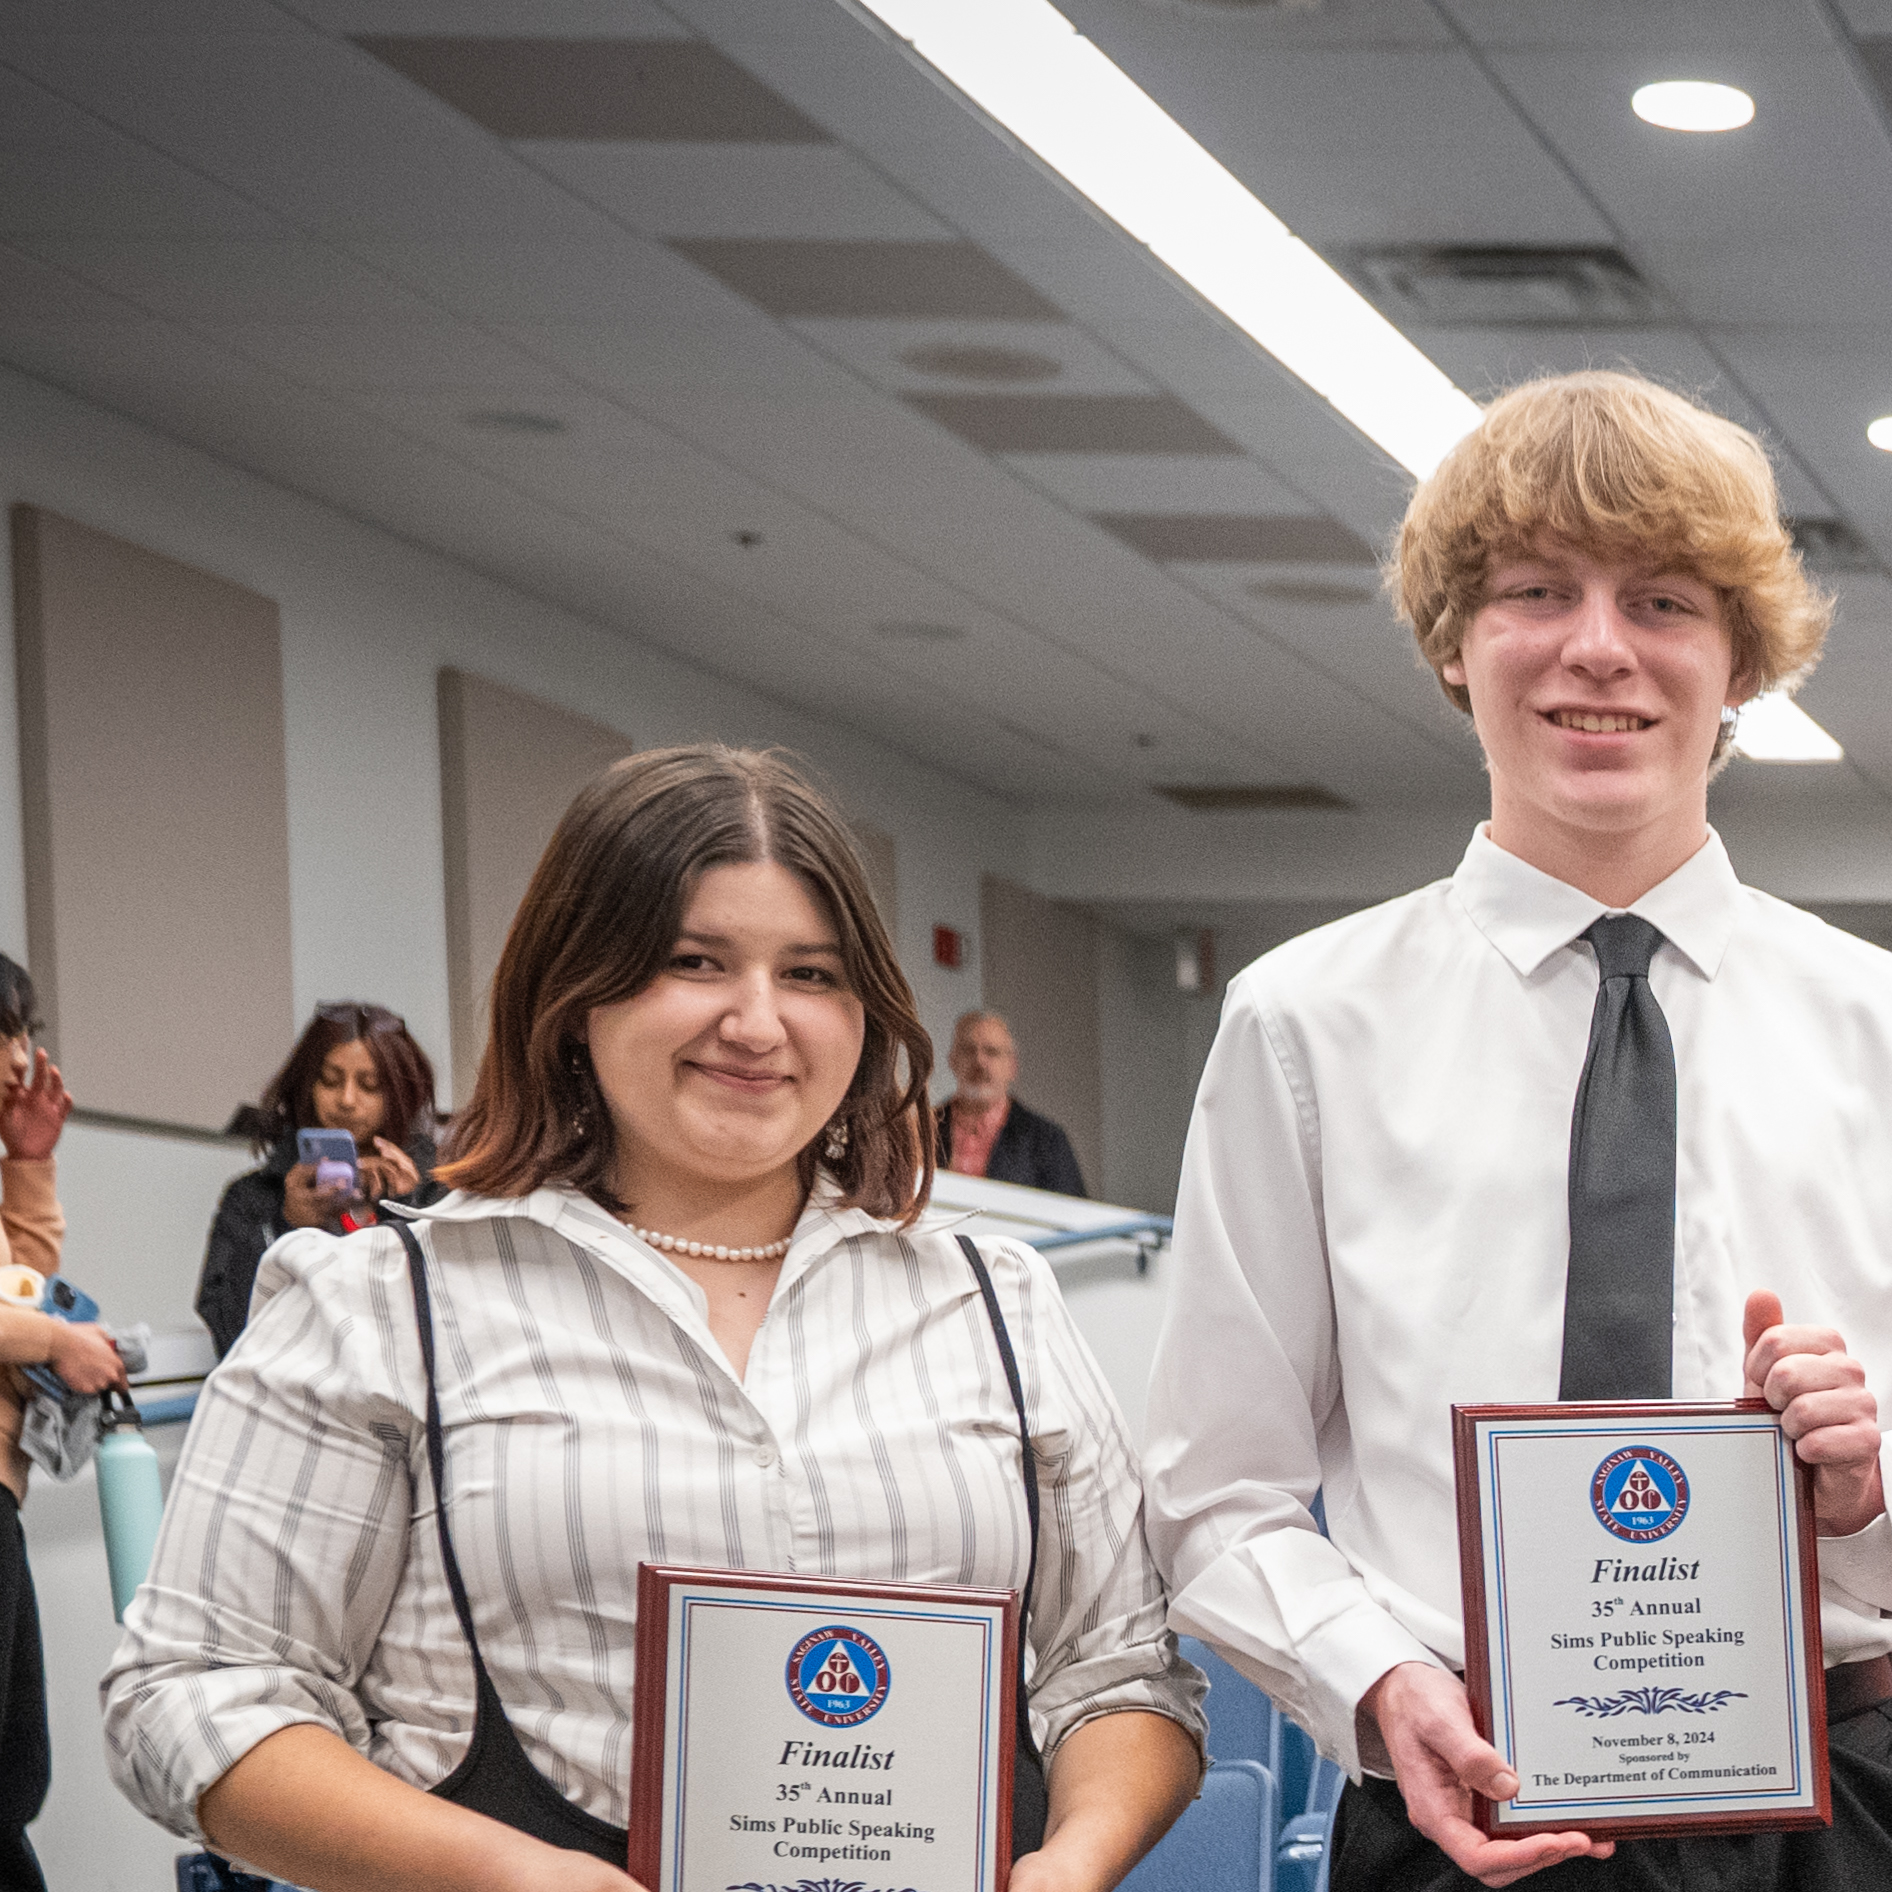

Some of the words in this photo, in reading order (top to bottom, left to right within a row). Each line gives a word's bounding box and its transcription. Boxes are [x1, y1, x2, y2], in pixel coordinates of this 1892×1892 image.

[1595, 1450, 1633, 1486] SAGINAW
[1649, 1451, 1684, 1484] VALLEY
[1596, 1499, 1622, 1531] STATE
[1630, 1499, 1687, 1540] UNIVERSITY
[1632, 1516, 1654, 1526] 1963
[1590, 1556, 1700, 1583] Finalist
[1591, 1596, 1624, 1618] 35th
[1630, 1597, 1701, 1616] Annual
[792, 1630, 834, 1663] SAGINAW
[852, 1633, 886, 1670] VALLEY
[1550, 1633, 1595, 1649] Sims
[1600, 1630, 1657, 1648] Public
[1662, 1627, 1745, 1649] Speaking
[1593, 1651, 1705, 1674] Competition
[790, 1678, 814, 1712] STATE
[823, 1686, 887, 1724] UNIVERSITY
[826, 1699, 850, 1710] 1963
[1592, 1734, 1664, 1748] November
[1667, 1732, 1680, 1746] 8,
[1683, 1731, 1716, 1745] 2024
[778, 1740, 895, 1771] Finalist
[1618, 1751, 1675, 1766] Sponsored
[1676, 1751, 1690, 1763] by
[1532, 1774, 1560, 1787] The
[1563, 1771, 1647, 1788] Department
[1650, 1768, 1666, 1781] of
[1667, 1763, 1778, 1780] Communication
[775, 1781, 811, 1802] 35th
[816, 1787, 892, 1806] Annual
[729, 1814, 776, 1833] Sims
[783, 1817, 843, 1836] Public
[848, 1819, 935, 1844] Speaking
[773, 1840, 891, 1864] Competition
